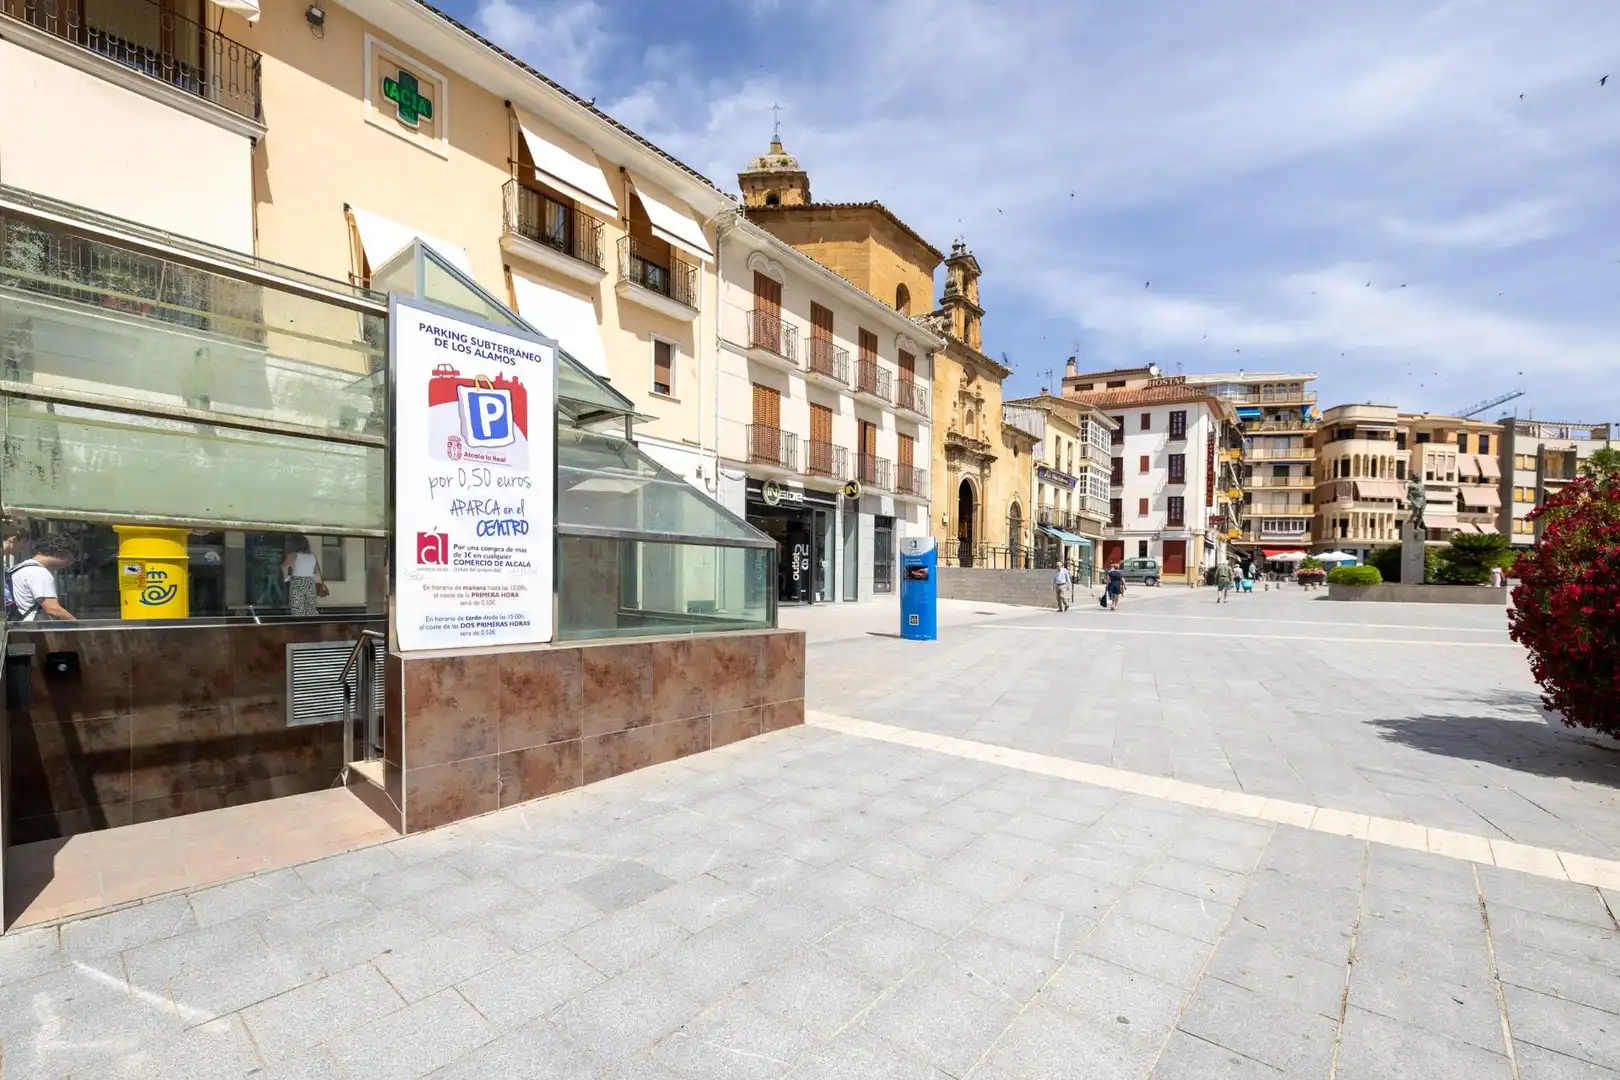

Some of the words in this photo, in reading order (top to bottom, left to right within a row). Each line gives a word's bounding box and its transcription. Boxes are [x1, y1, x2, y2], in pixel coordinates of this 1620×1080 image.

[419, 322, 468, 343] PARKING
[434, 337, 448, 349] DE
[452, 342, 472, 355] LOS
[478, 395, 505, 437] P
[428, 475, 454, 500] por
[458, 467, 492, 490] 0,50
[497, 475, 532, 489] euros
[449, 498, 501, 517] APARCA
[503, 506, 515, 515] en
[516, 498, 525, 517] el
[476, 518, 529, 537] CENTRO
[464, 551, 472, 559] 3€
[483, 552, 512, 561] cualquier
[480, 545, 505, 555] compra
[506, 545, 514, 553] de
[453, 559, 493, 567] COMERCIO
[494, 560, 504, 568] DE
[792, 551, 800, 581] outlet
[423, 583, 431, 591] En
[454, 583, 462, 591] de
[463, 583, 486, 591] mañana
[425, 615, 434, 623] En
[457, 614, 464, 622] de
[465, 613, 482, 621] tarde
